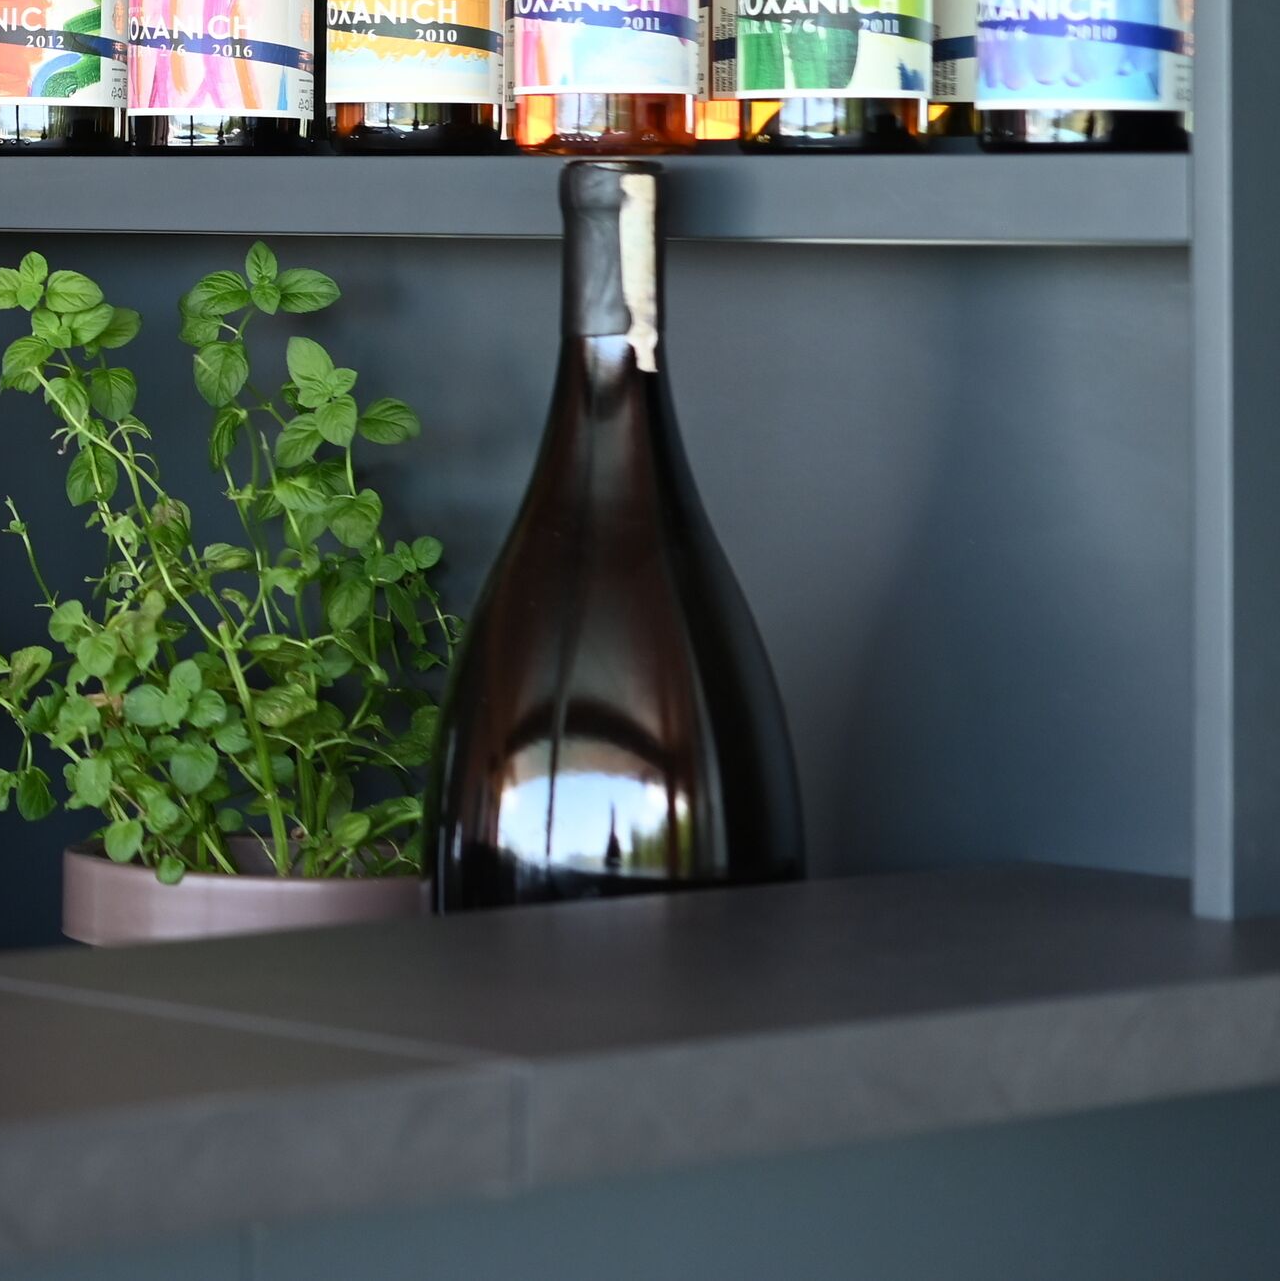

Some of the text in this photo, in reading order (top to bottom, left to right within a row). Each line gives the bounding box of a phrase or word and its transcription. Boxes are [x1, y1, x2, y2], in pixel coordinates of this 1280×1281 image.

[129, 15, 253, 41] OXANICH
[622, 16, 661, 31] 2011
[859, 19, 899, 34] 2011
[26, 35, 65, 49] 2012
[415, 28, 458, 43] 2010
[212, 43, 253, 58] 2016
